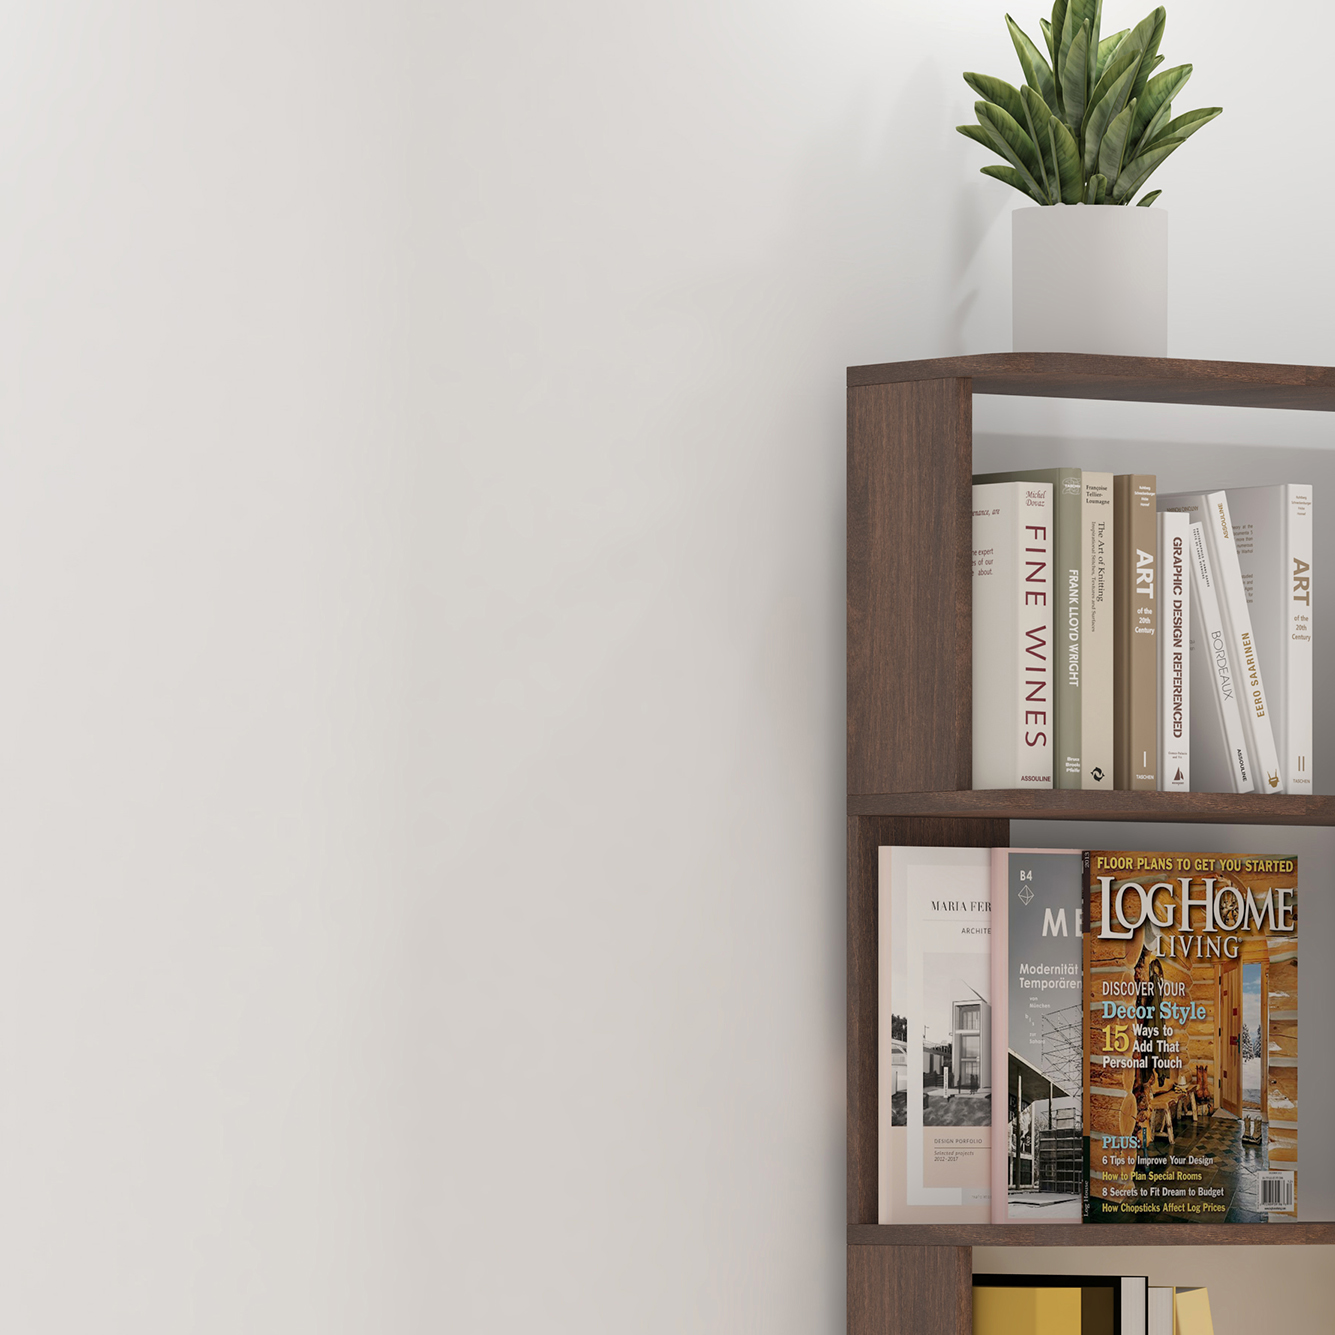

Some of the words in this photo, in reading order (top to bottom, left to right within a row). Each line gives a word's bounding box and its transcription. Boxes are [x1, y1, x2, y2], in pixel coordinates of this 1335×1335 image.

[1025, 490, 1046, 499] Michel
[1025, 499, 1045, 507] Dovaz
[1097, 521, 1105, 538] The
[1217, 503, 1229, 539] ASSOULINE
[1025, 526, 1046, 606] FINE
[1098, 556, 1105, 566] of
[1173, 536, 1183, 596] GRAPHIC
[1136, 549, 1154, 599] ART
[1293, 557, 1310, 606] ART
[1069, 569, 1079, 604] FRANK
[1096, 567, 1105, 602] Knitting
[1137, 607, 1143, 615] of
[1069, 606, 1079, 641] LLOYD
[1135, 626, 1155, 636] Century
[1173, 600, 1183, 648] DESIGN
[1292, 634, 1311, 642] Century
[1069, 643, 1079, 687] WRIGHT
[1211, 630, 1233, 701] BORDEAUX
[1241, 632, 1259, 687] SAARINEN
[1025, 625, 1047, 747] WINES
[1173, 652, 1183, 738] REFERENCED
[1252, 690, 1265, 718] EERO
[1237, 749, 1248, 782] ASSOULINE
[1097, 857, 1133, 870] FLOOR
[1137, 857, 1173, 871] PLANS
[1177, 858, 1191, 871] TO
[1194, 858, 1216, 871] GET
[1219, 859, 1241, 872] YOU
[1245, 859, 1294, 872] STARTED
[1020, 870, 1033, 881] B4
[931, 900, 967, 912] MARIA
[1156, 935, 1239, 958] LIVING
[1019, 963, 1078, 975] Modernität
[1102, 981, 1155, 996] DISCOVER
[1157, 982, 1186, 997] YOUR
[1101, 1001, 1155, 1019] Decor
[1159, 1001, 1206, 1025] Style
[1102, 1024, 1130, 1052] 15
[1132, 1023, 1159, 1038] Ways
[1163, 1024, 1174, 1036] to
[1132, 1040, 1153, 1052] Add
[1157, 1040, 1180, 1052] That
[1102, 1056, 1148, 1069] Personal
[1152, 1056, 1182, 1069] Touch
[1102, 1136, 1141, 1149] PLUS:
[1102, 1156, 1108, 1165] 6
[1110, 1156, 1125, 1166] Tips
[1127, 1156, 1135, 1165] to
[1137, 1156, 1167, 1166] Improve
[1169, 1156, 1186, 1165] Your
[1188, 1156, 1214, 1166] Design
[1102, 1171, 1118, 1180] How
[1121, 1172, 1128, 1180] to
[1130, 1172, 1146, 1181] Plan
[1148, 1171, 1175, 1182] Special
[1177, 1171, 1202, 1180] Rooms
[1102, 1187, 1108, 1196] 8
[1110, 1187, 1138, 1196] Secrets
[1140, 1187, 1148, 1196] to
[1150, 1187, 1160, 1196] Fit
[1162, 1187, 1186, 1196] Dream
[1188, 1188, 1196, 1196] to
[1198, 1187, 1224, 1198] Budget
[1102, 1203, 1118, 1212] How
[1121, 1203, 1160, 1213] Chopsticks
[1162, 1203, 1185, 1212] Affect
[1187, 1203, 1201, 1213] Log
[1203, 1203, 1226, 1212] Prices
